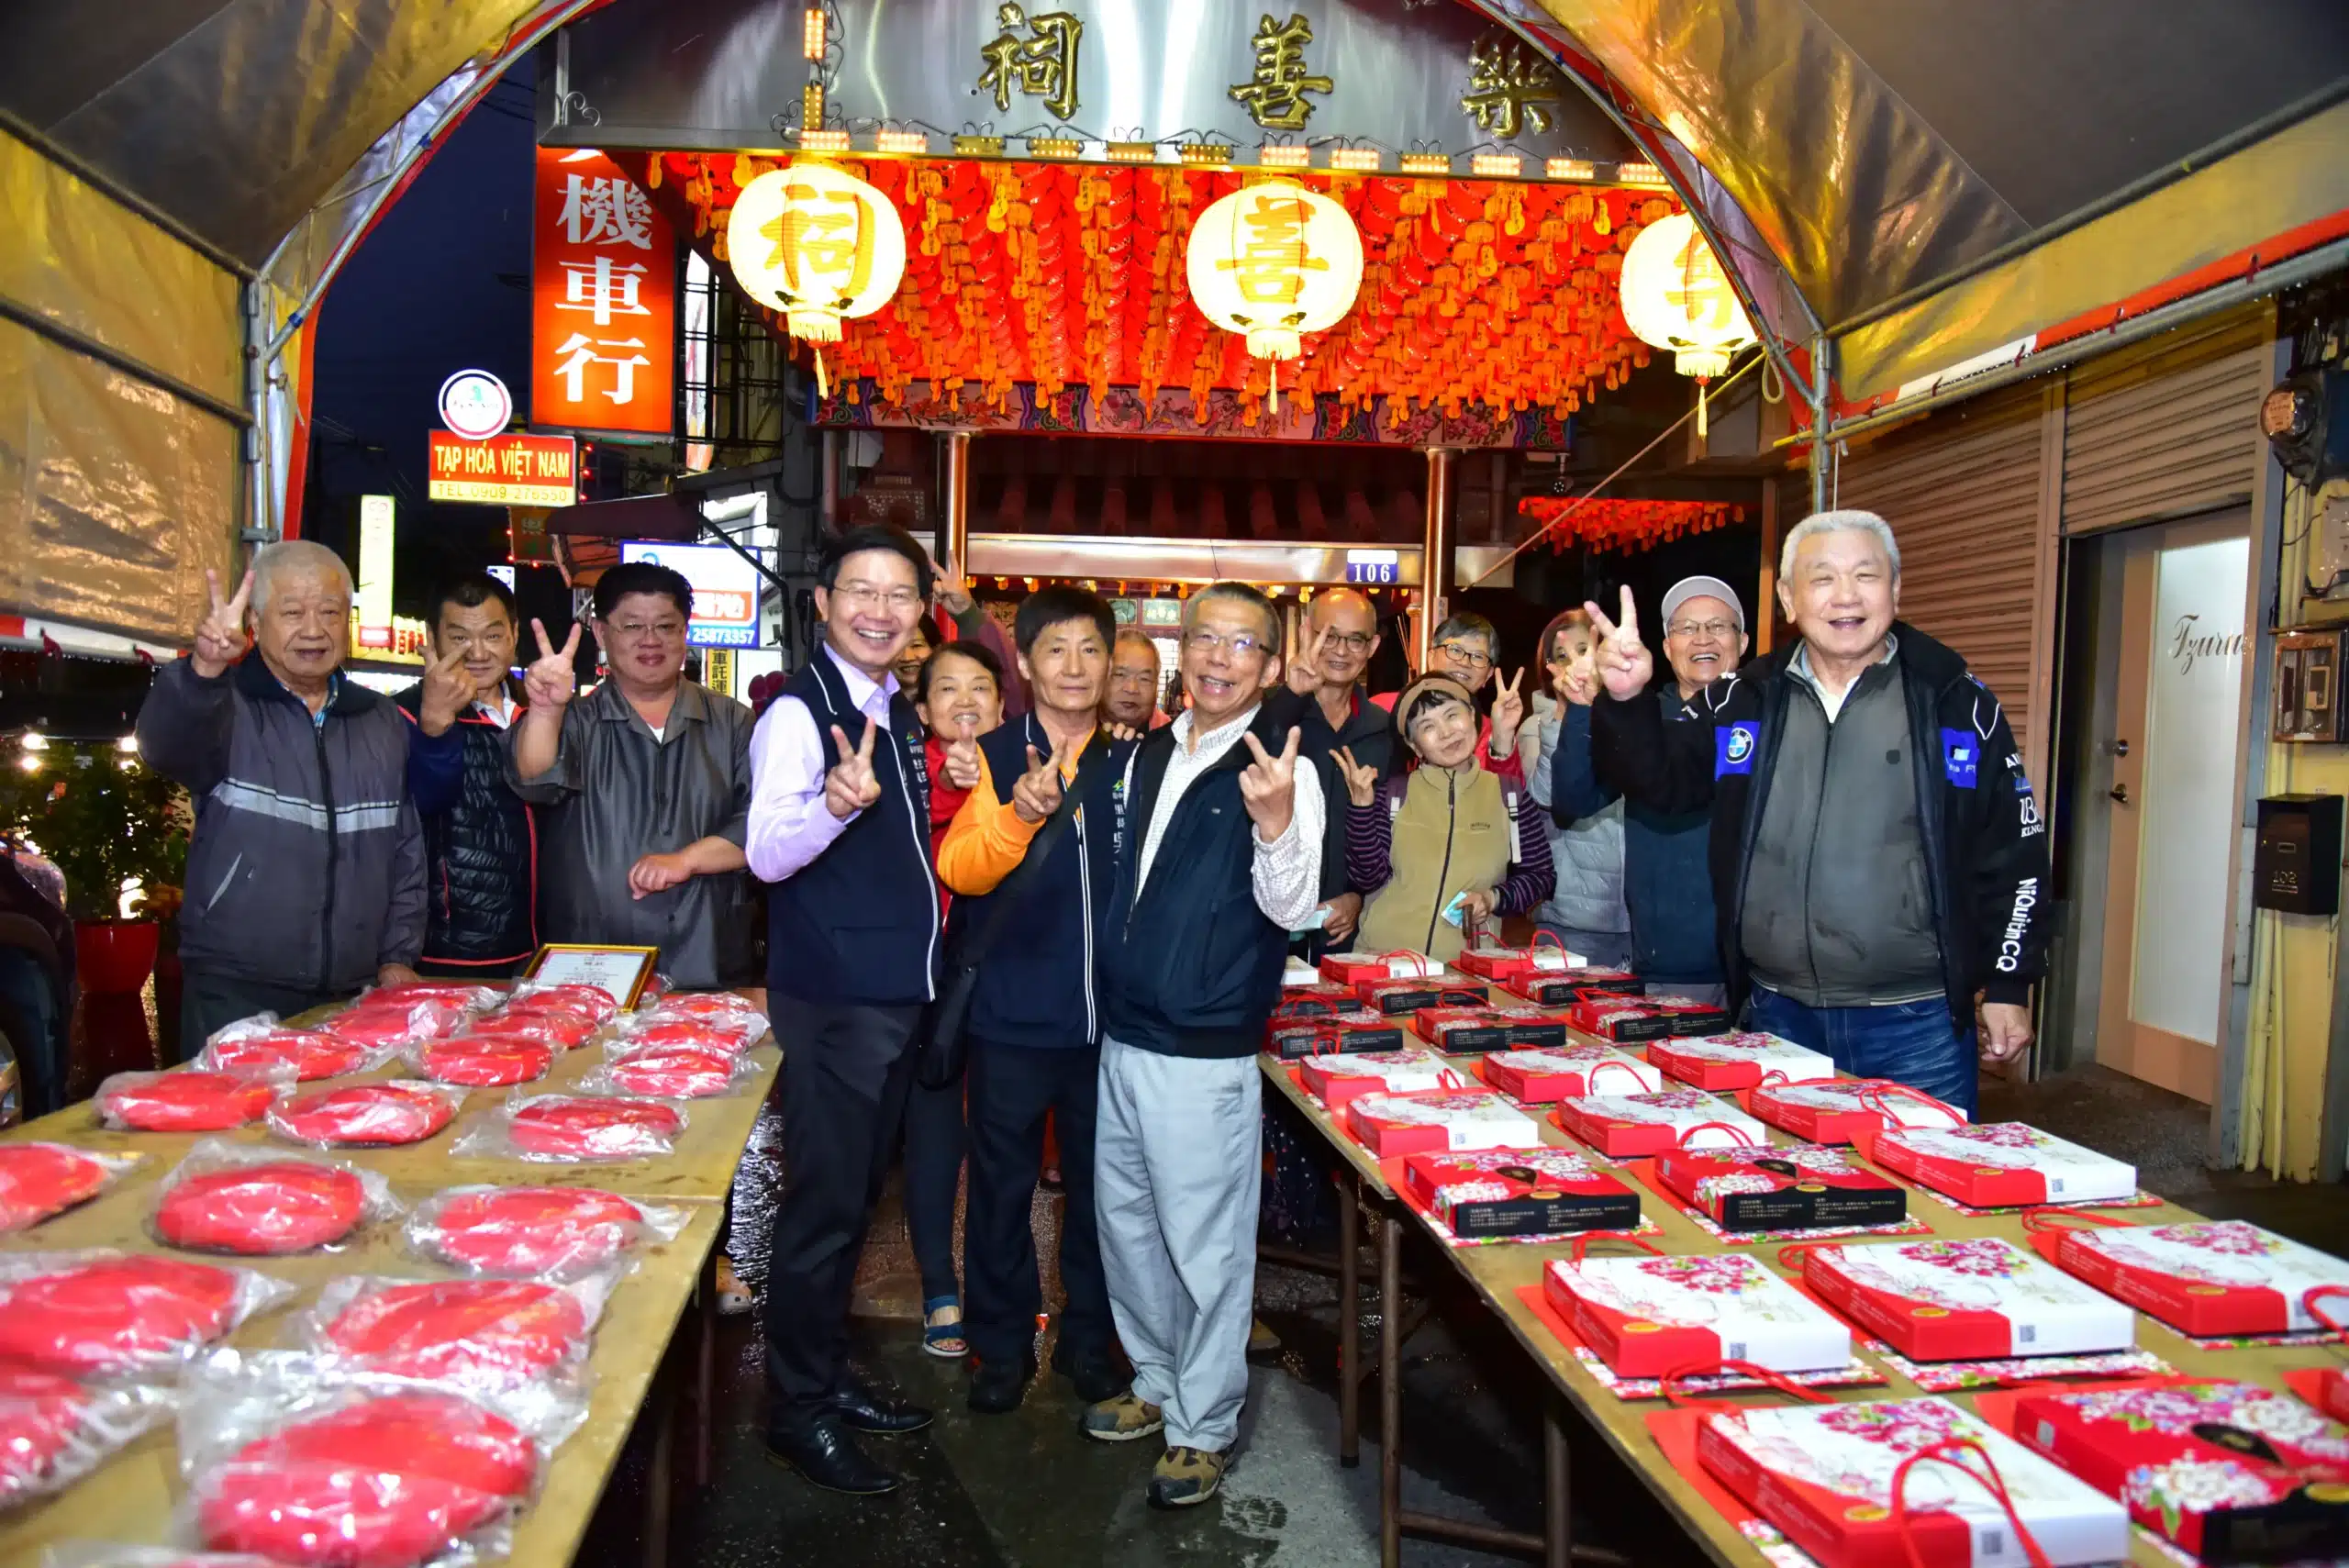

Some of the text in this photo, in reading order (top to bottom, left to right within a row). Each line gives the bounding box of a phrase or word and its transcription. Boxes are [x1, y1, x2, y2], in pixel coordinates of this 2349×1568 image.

[554, 150, 652, 405] 機車行
[435, 445, 462, 478] TẠP
[465, 440, 496, 474] HÓA
[538, 450, 570, 478] NAM
[438, 484, 463, 496] TEL
[1354, 564, 1390, 583] 106
